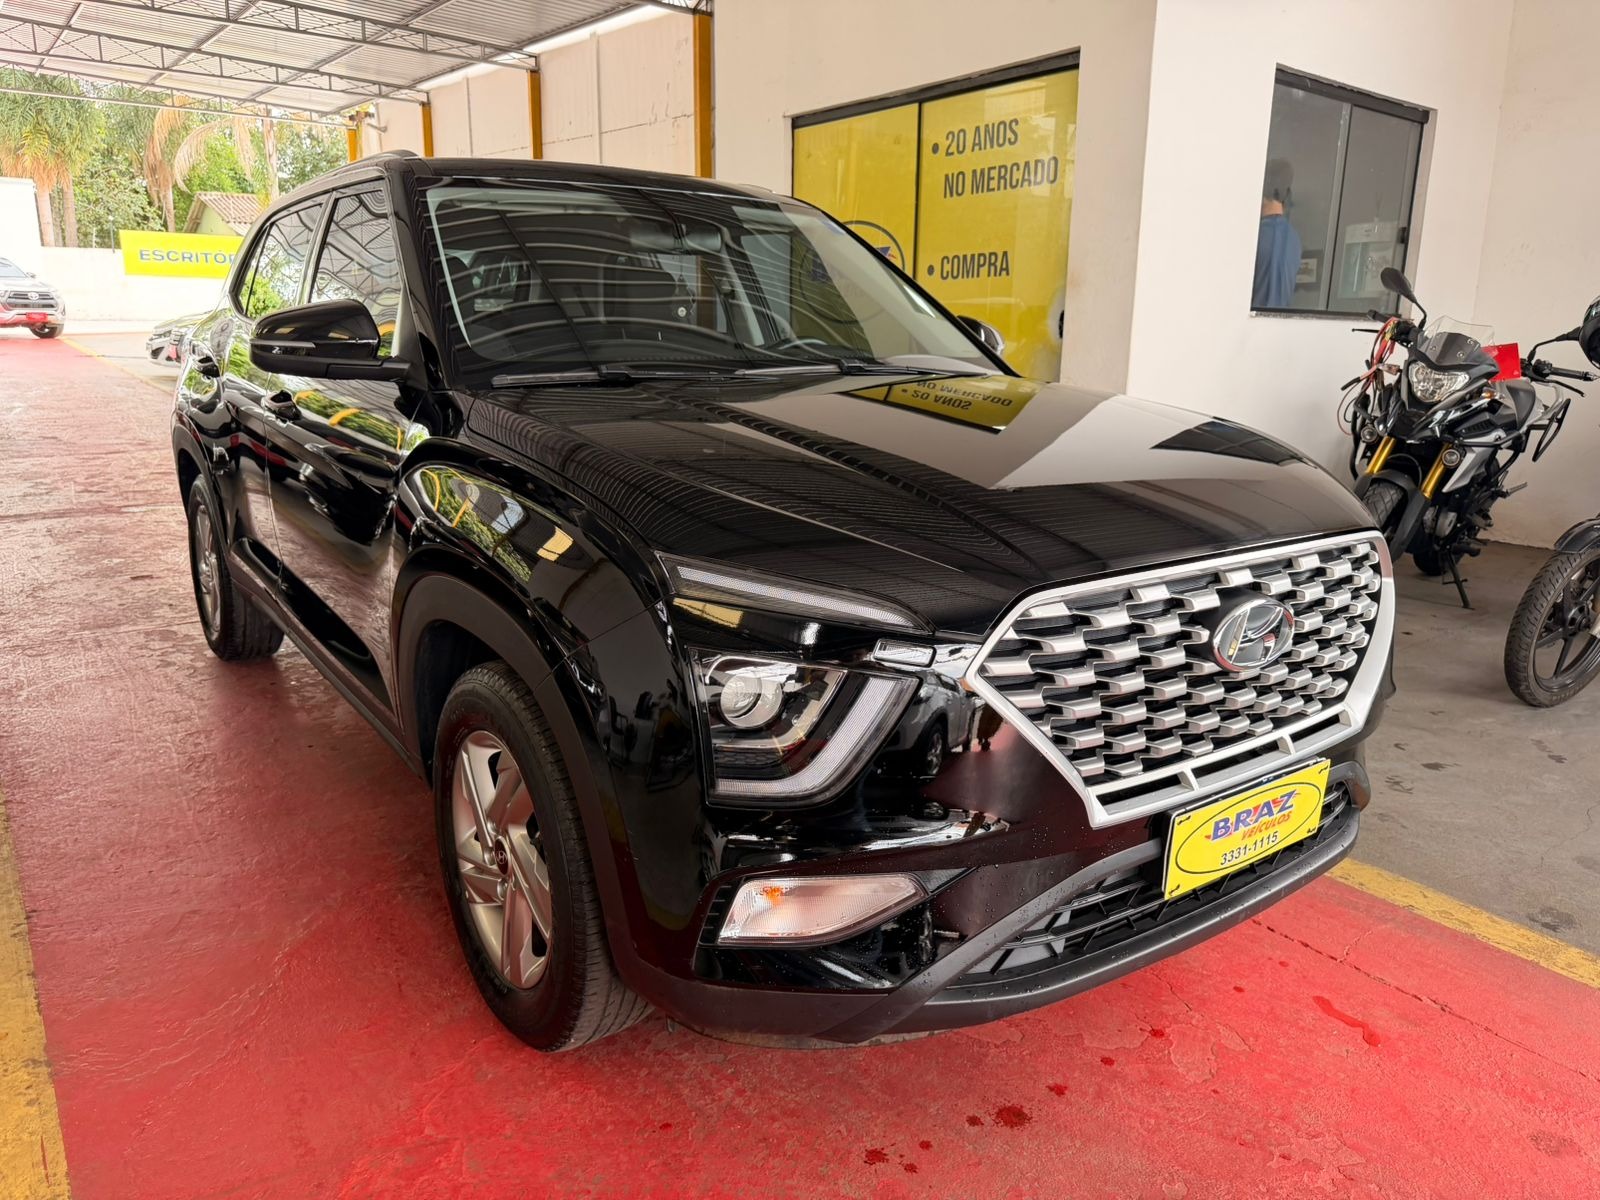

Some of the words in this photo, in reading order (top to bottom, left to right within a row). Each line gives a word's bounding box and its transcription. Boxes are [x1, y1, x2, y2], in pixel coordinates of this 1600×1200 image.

[945, 128, 967, 157] 20
[971, 118, 1019, 153] ANOS
[943, 170, 966, 199] NO
[970, 156, 1059, 195] MERCADO
[940, 250, 1011, 281] COMPRA
[1211, 789, 1297, 841] BRAZ
[1220, 831, 1279, 866] 3331-1115
